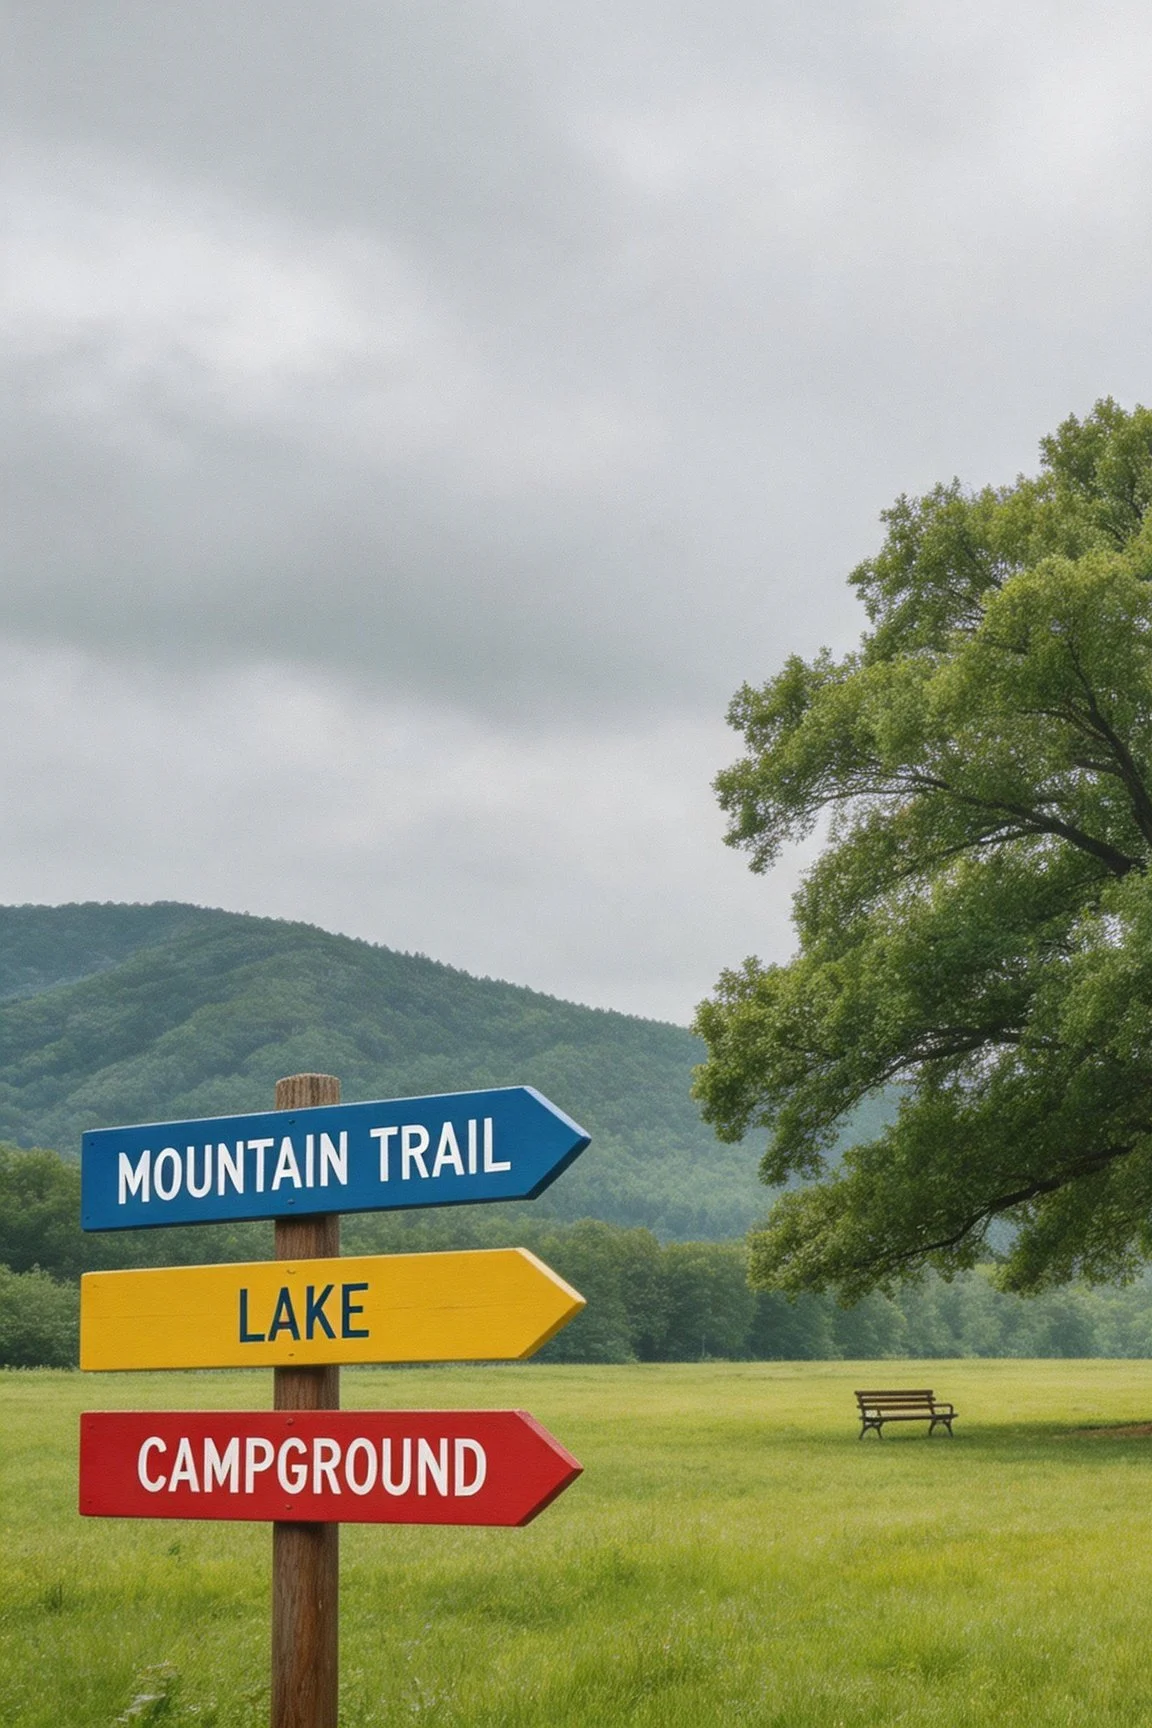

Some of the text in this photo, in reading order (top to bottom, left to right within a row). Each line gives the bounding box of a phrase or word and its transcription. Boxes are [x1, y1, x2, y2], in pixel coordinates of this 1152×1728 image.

[118, 1117, 511, 1205] MOUNTAIN TRAIL
[239, 1282, 370, 1343] LAKE
[137, 1436, 487, 1497] CAMPGROUND
